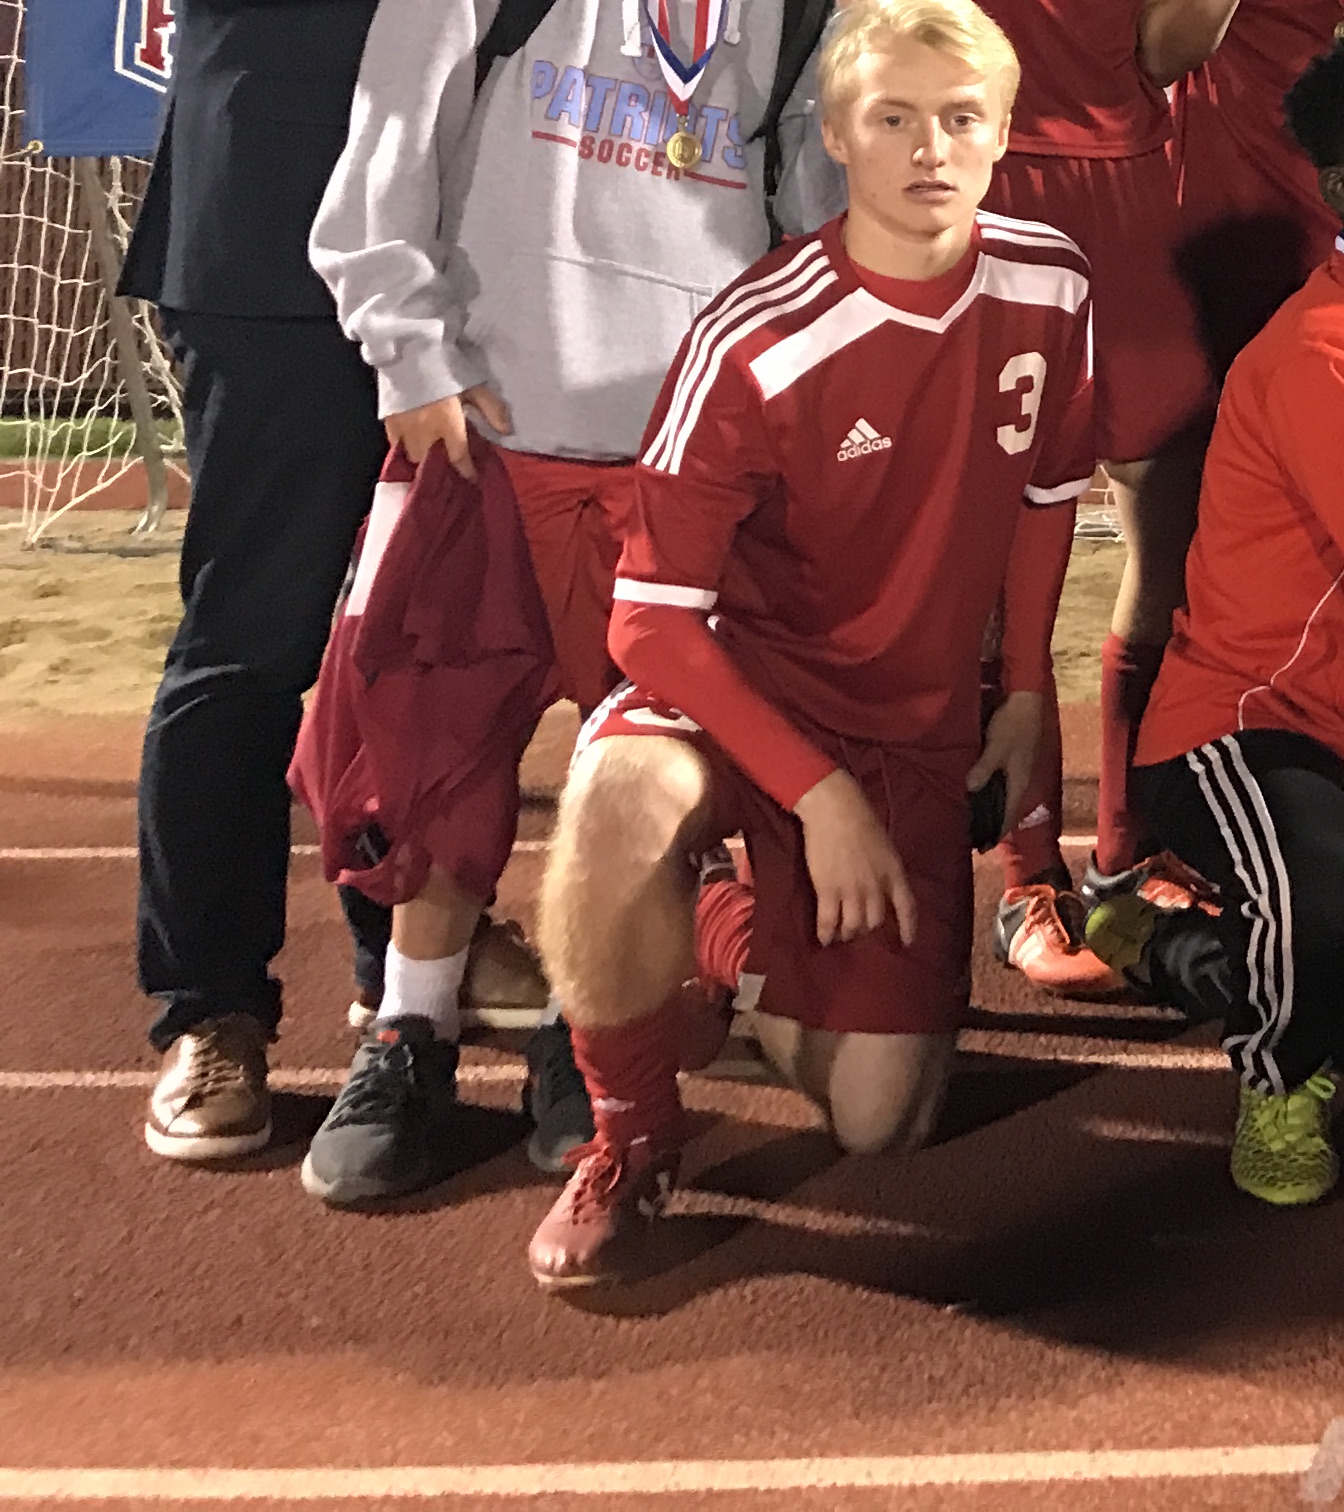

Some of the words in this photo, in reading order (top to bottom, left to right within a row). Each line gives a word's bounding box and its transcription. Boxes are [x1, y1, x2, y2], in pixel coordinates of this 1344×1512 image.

[577, 134, 681, 182] SOCCER
[995, 350, 1048, 457] 3
[836, 435, 894, 463] adidas
